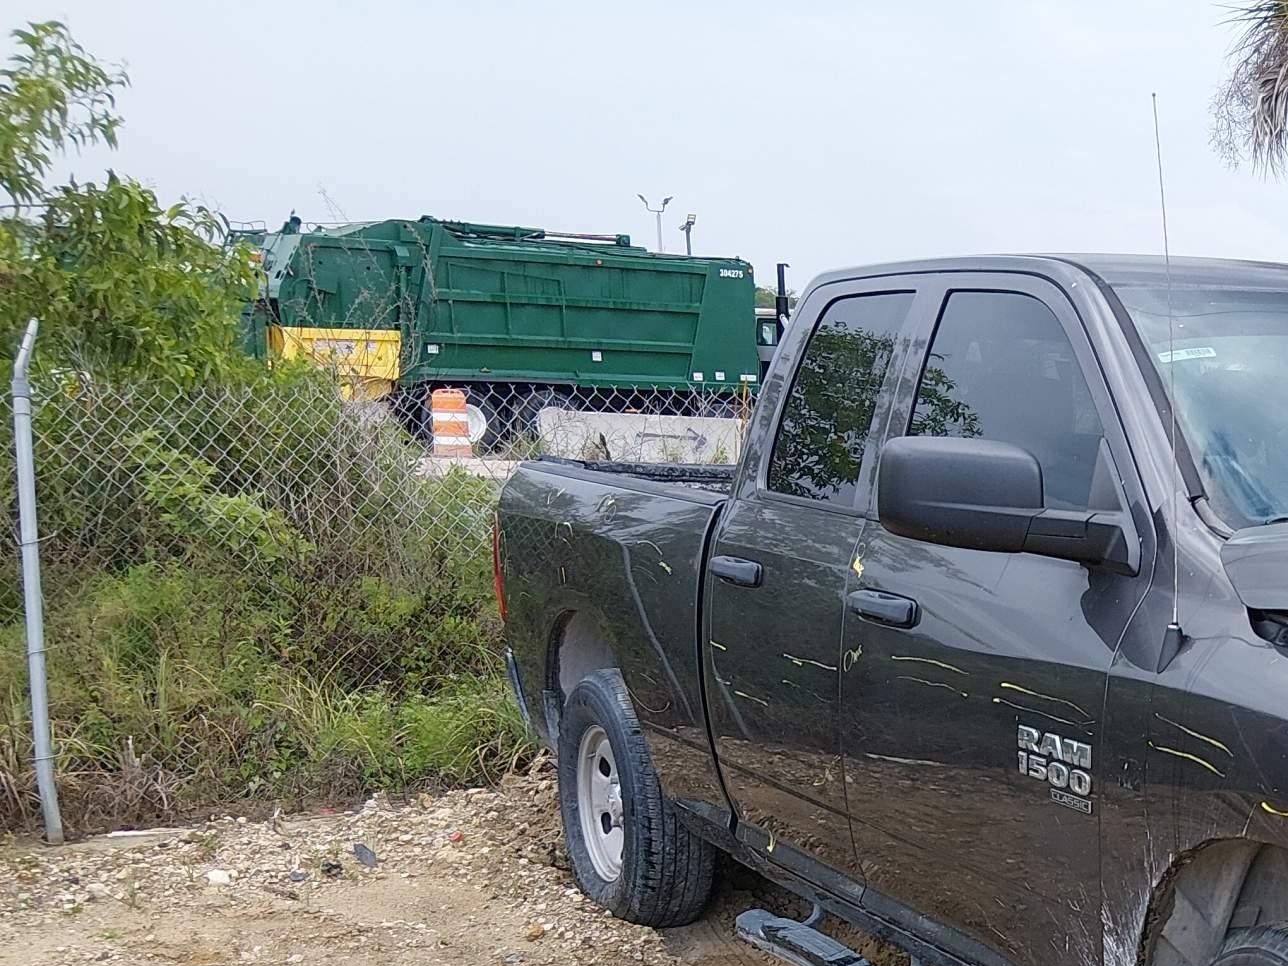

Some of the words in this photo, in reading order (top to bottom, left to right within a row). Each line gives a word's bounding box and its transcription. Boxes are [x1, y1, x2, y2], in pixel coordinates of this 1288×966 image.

[719, 268, 744, 278] 304275
[1017, 724, 1093, 770] RAM
[1017, 750, 1092, 797] 1500
[1051, 789, 1091, 814] CLASSIC
